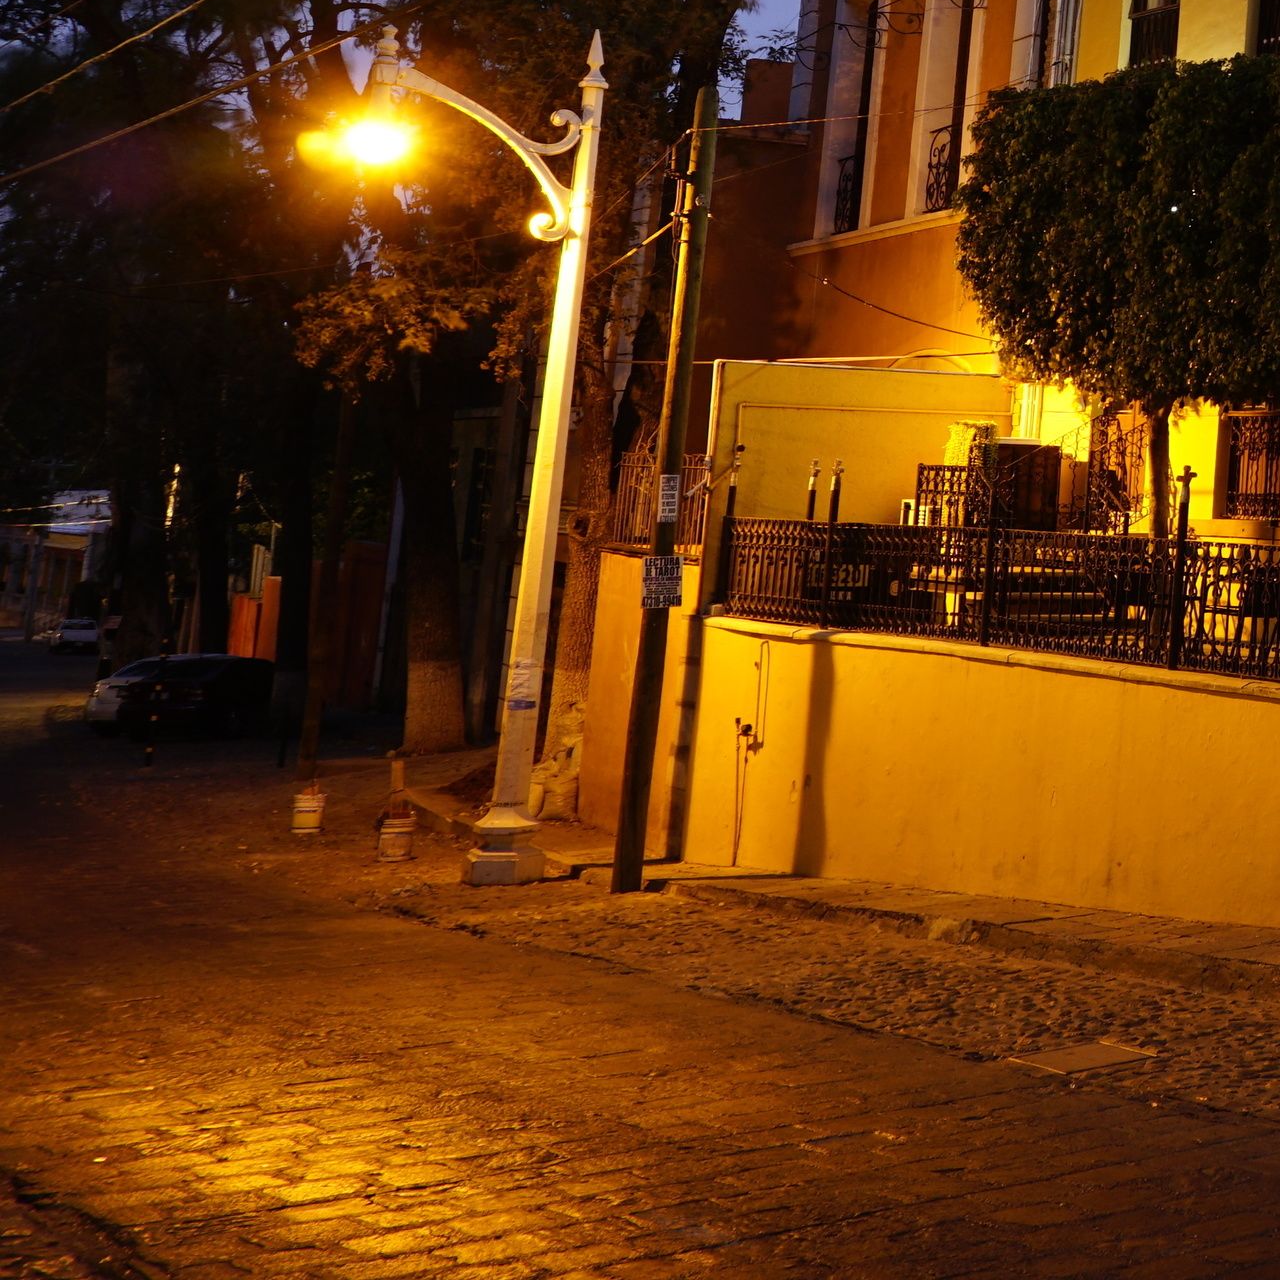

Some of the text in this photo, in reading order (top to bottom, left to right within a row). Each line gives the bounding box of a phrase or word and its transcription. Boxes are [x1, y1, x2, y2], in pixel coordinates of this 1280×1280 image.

[645, 557, 680, 567] LECTURA
[645, 566, 680, 577] DE TAROT
